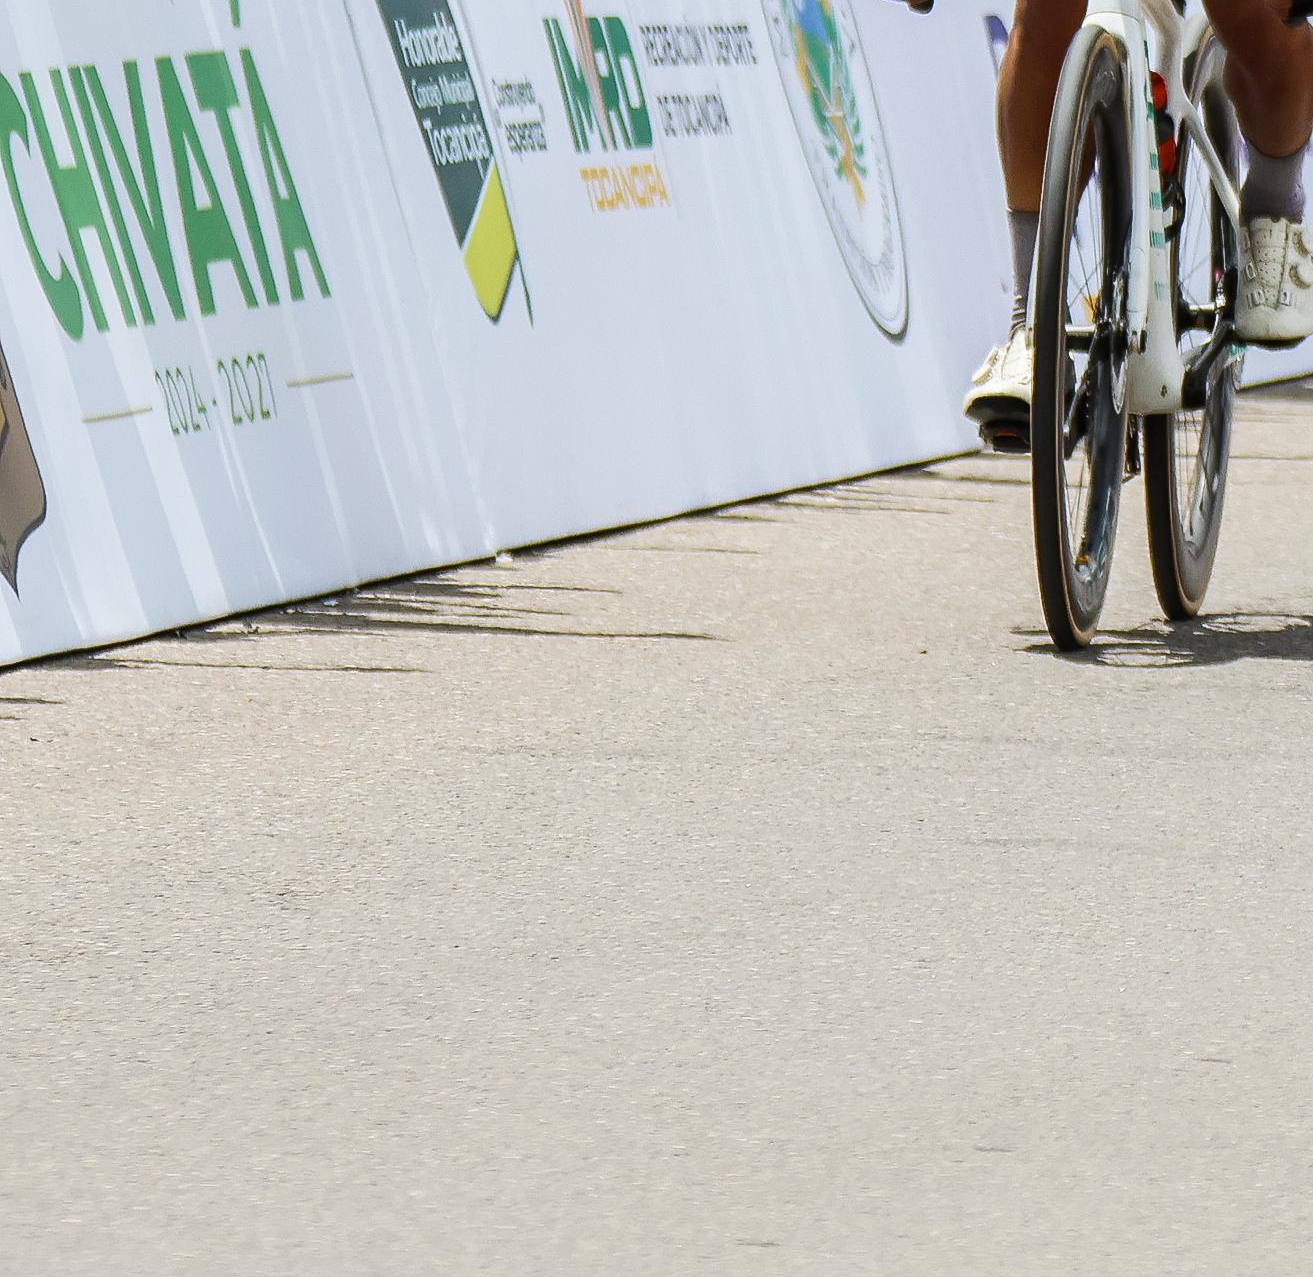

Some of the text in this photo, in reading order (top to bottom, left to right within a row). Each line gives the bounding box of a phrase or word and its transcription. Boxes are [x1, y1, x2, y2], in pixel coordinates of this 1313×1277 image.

[393, 10, 463, 68] Honorable
[422, 112, 491, 181] Tocancipá
[153, 364, 211, 436] 2024
[217, 351, 278, 426] 2027
